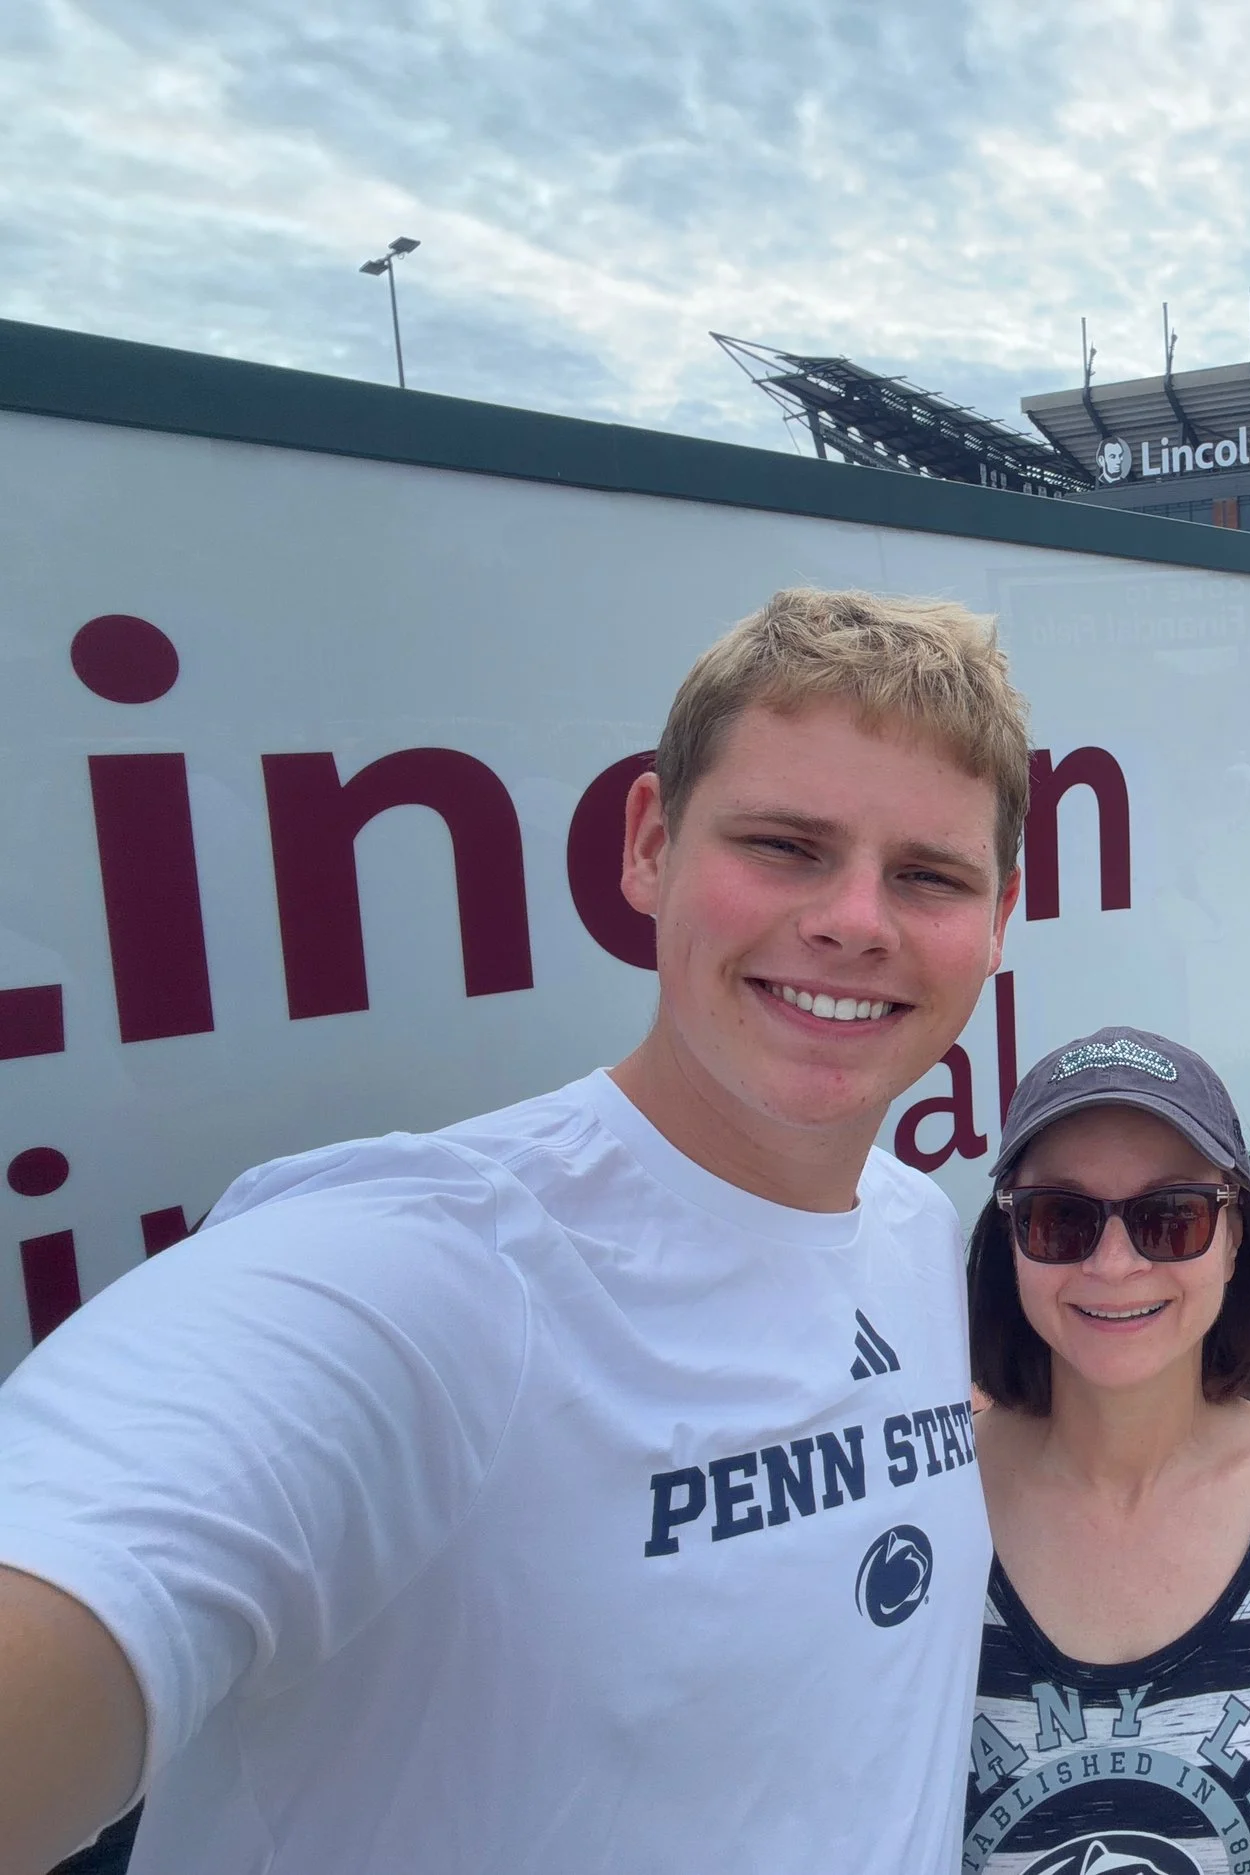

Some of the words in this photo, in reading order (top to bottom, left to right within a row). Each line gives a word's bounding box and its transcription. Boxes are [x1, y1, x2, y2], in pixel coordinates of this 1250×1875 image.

[644, 1425, 867, 1558] PENN
[962, 1752, 1154, 1872] TABLISHED
[1175, 1766, 1216, 1805] IN
